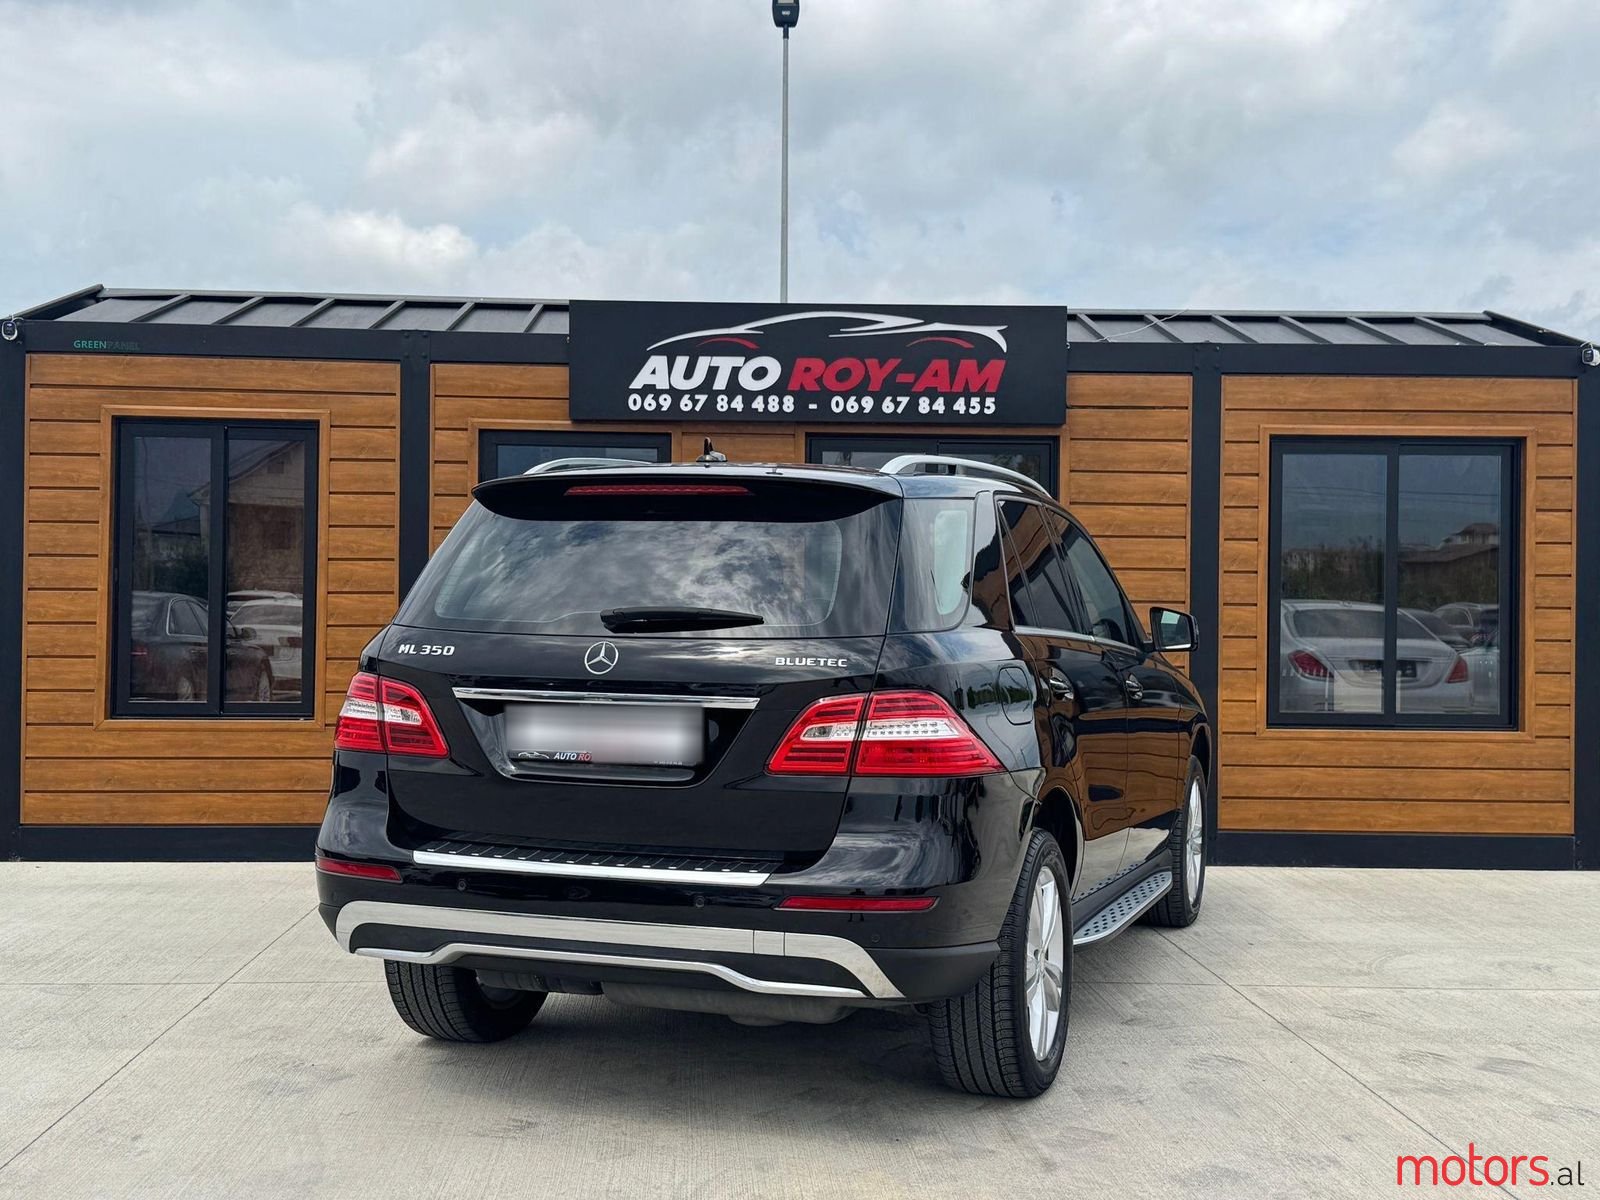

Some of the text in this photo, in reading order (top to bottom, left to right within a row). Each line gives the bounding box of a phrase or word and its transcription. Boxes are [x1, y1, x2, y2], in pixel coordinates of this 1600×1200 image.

[628, 354, 1006, 392] AUTO ROY-AM
[627, 393, 672, 411] 069
[679, 394, 708, 412] 67
[716, 394, 744, 412] 84
[751, 394, 795, 413] 488
[830, 395, 874, 414] 069
[881, 396, 910, 414] 67
[917, 396, 946, 414] 84
[952, 396, 996, 415] 455
[398, 644, 455, 656] ML 350
[775, 657, 848, 667] BLUETEC
[553, 752, 577, 760] AUTO
